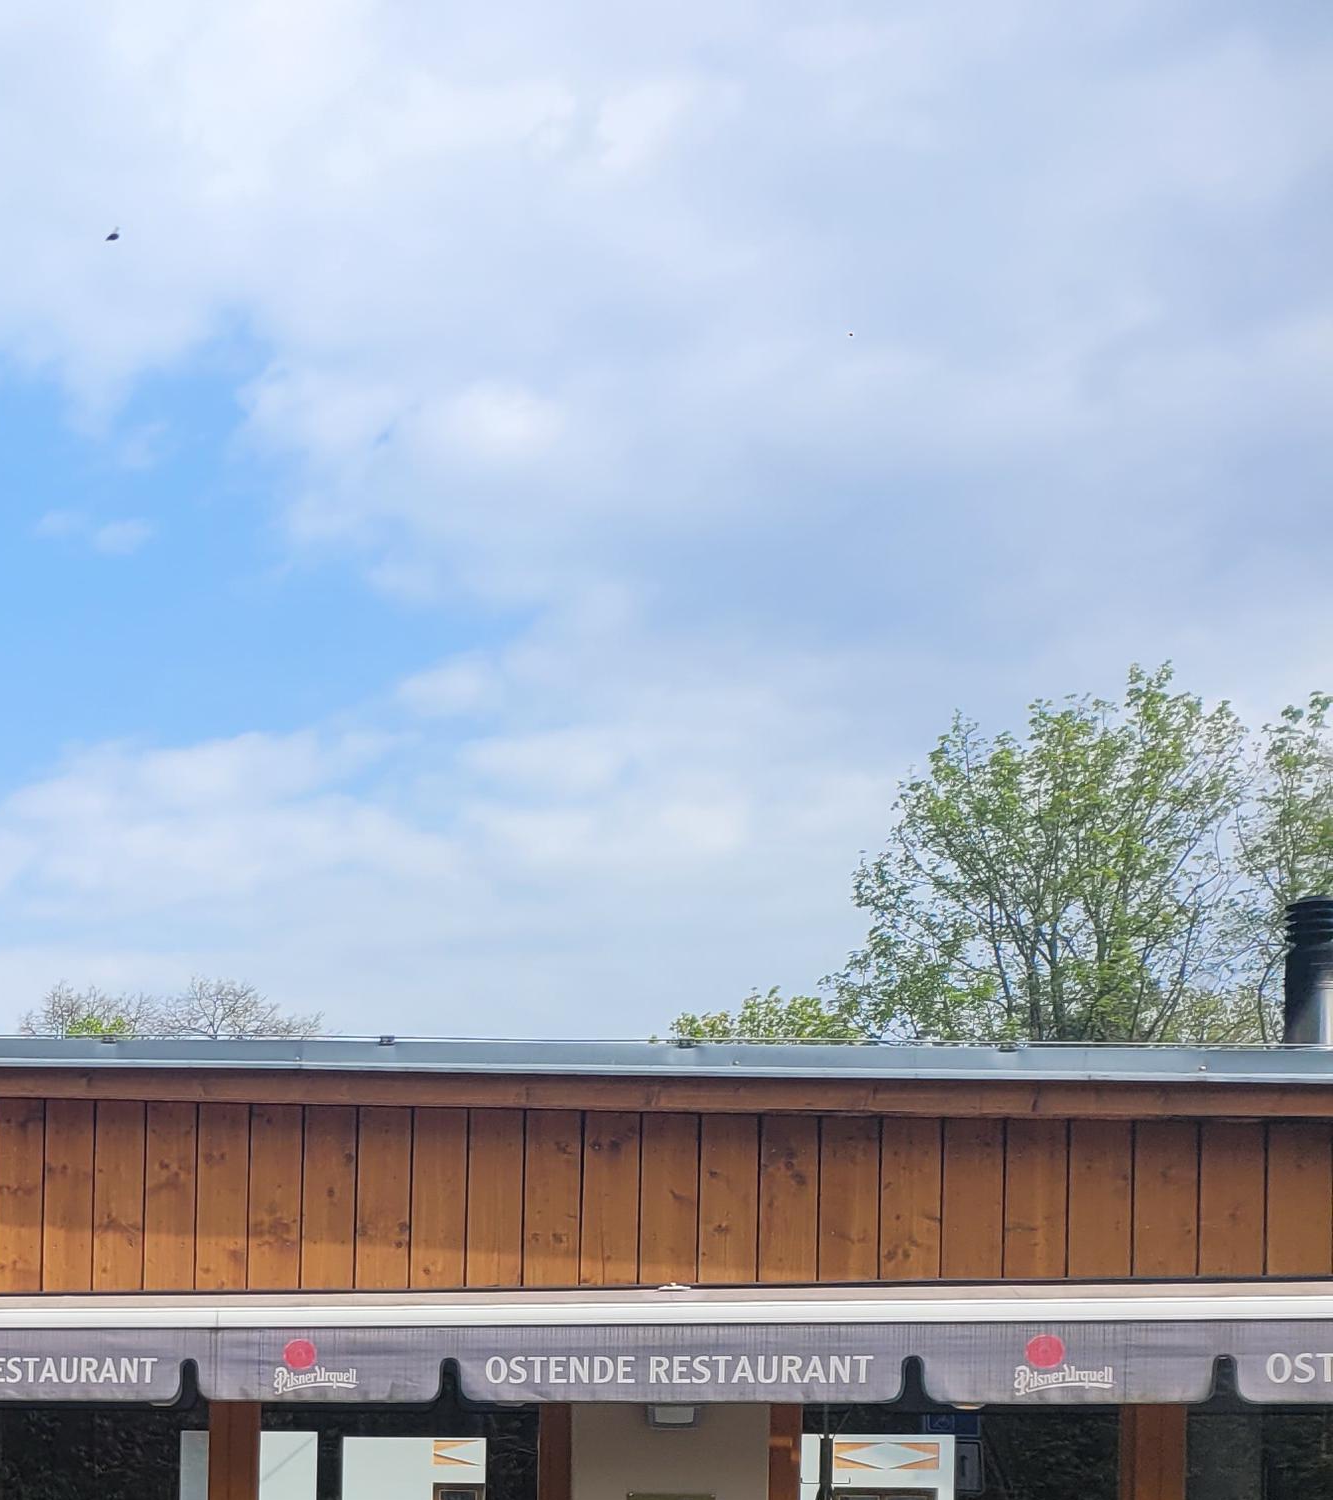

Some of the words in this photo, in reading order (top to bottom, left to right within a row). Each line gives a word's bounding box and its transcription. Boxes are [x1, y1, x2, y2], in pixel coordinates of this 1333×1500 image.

[274, 1367, 316, 1395] Pilsner
[315, 1365, 357, 1389] Urquell
[485, 1355, 636, 1384] OSTENDE
[648, 1354, 874, 1385] RESTAURANT
[1014, 1365, 1065, 1396] Pilsner
[1063, 1363, 1113, 1389] Urquell
